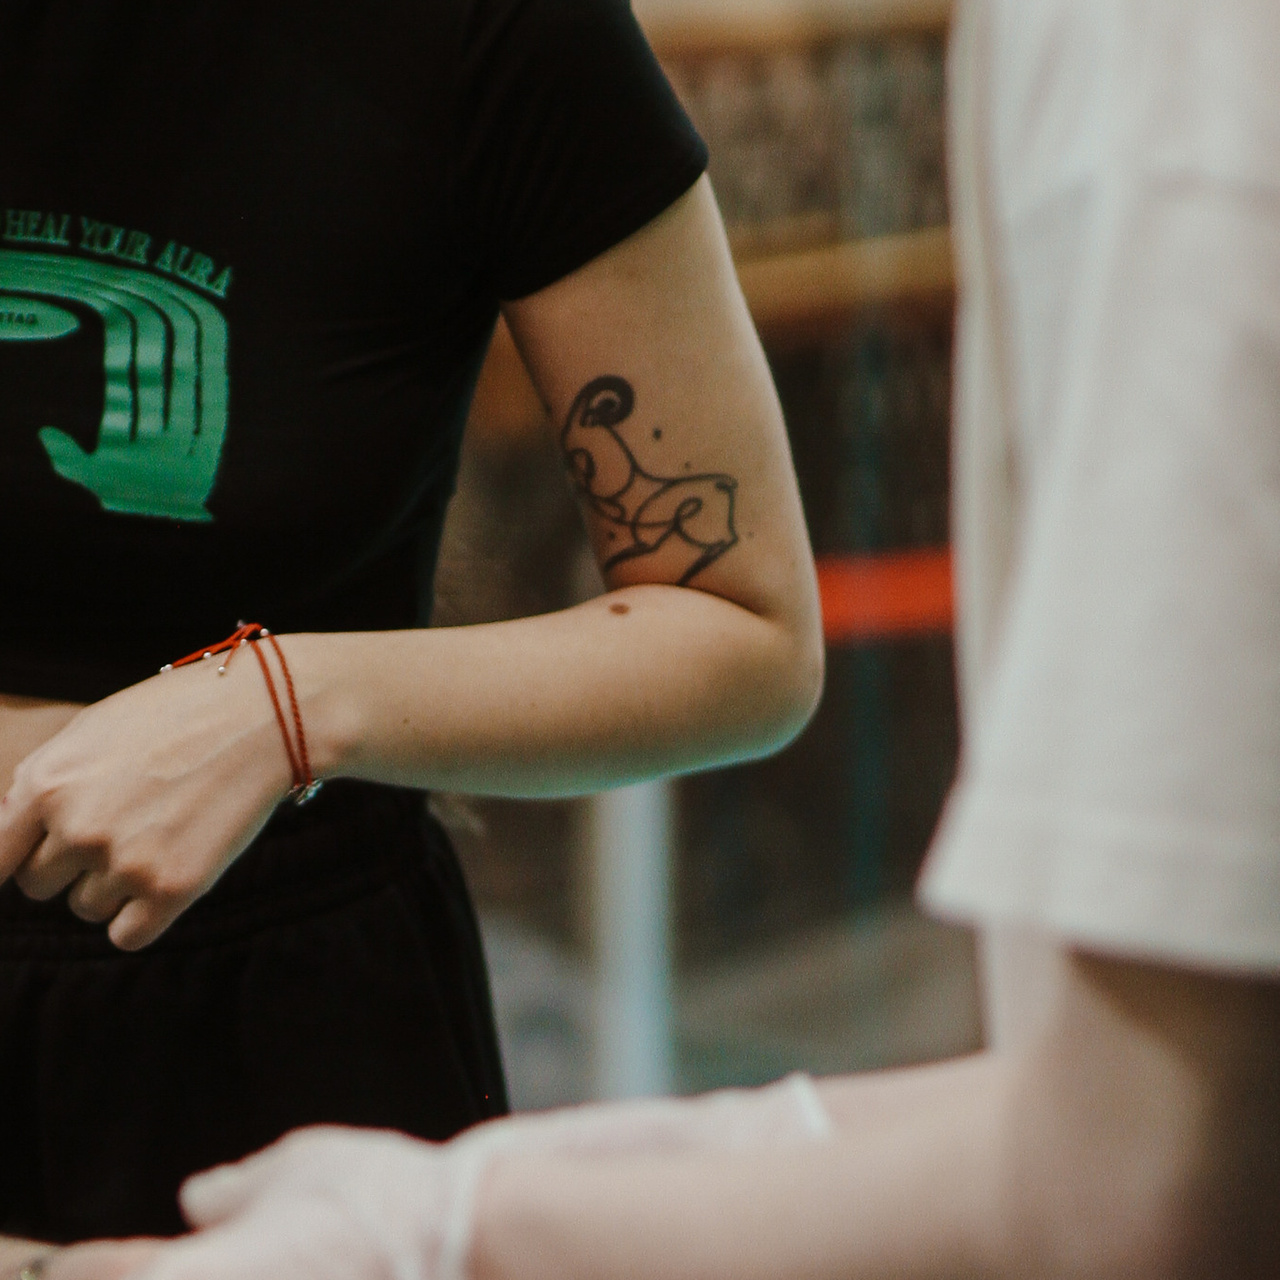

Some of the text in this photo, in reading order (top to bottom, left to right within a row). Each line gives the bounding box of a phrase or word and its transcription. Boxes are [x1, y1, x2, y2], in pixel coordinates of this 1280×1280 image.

[3, 208, 70, 246] HEAL
[78, 215, 151, 265] YOUR
[154, 239, 233, 299] AURA
